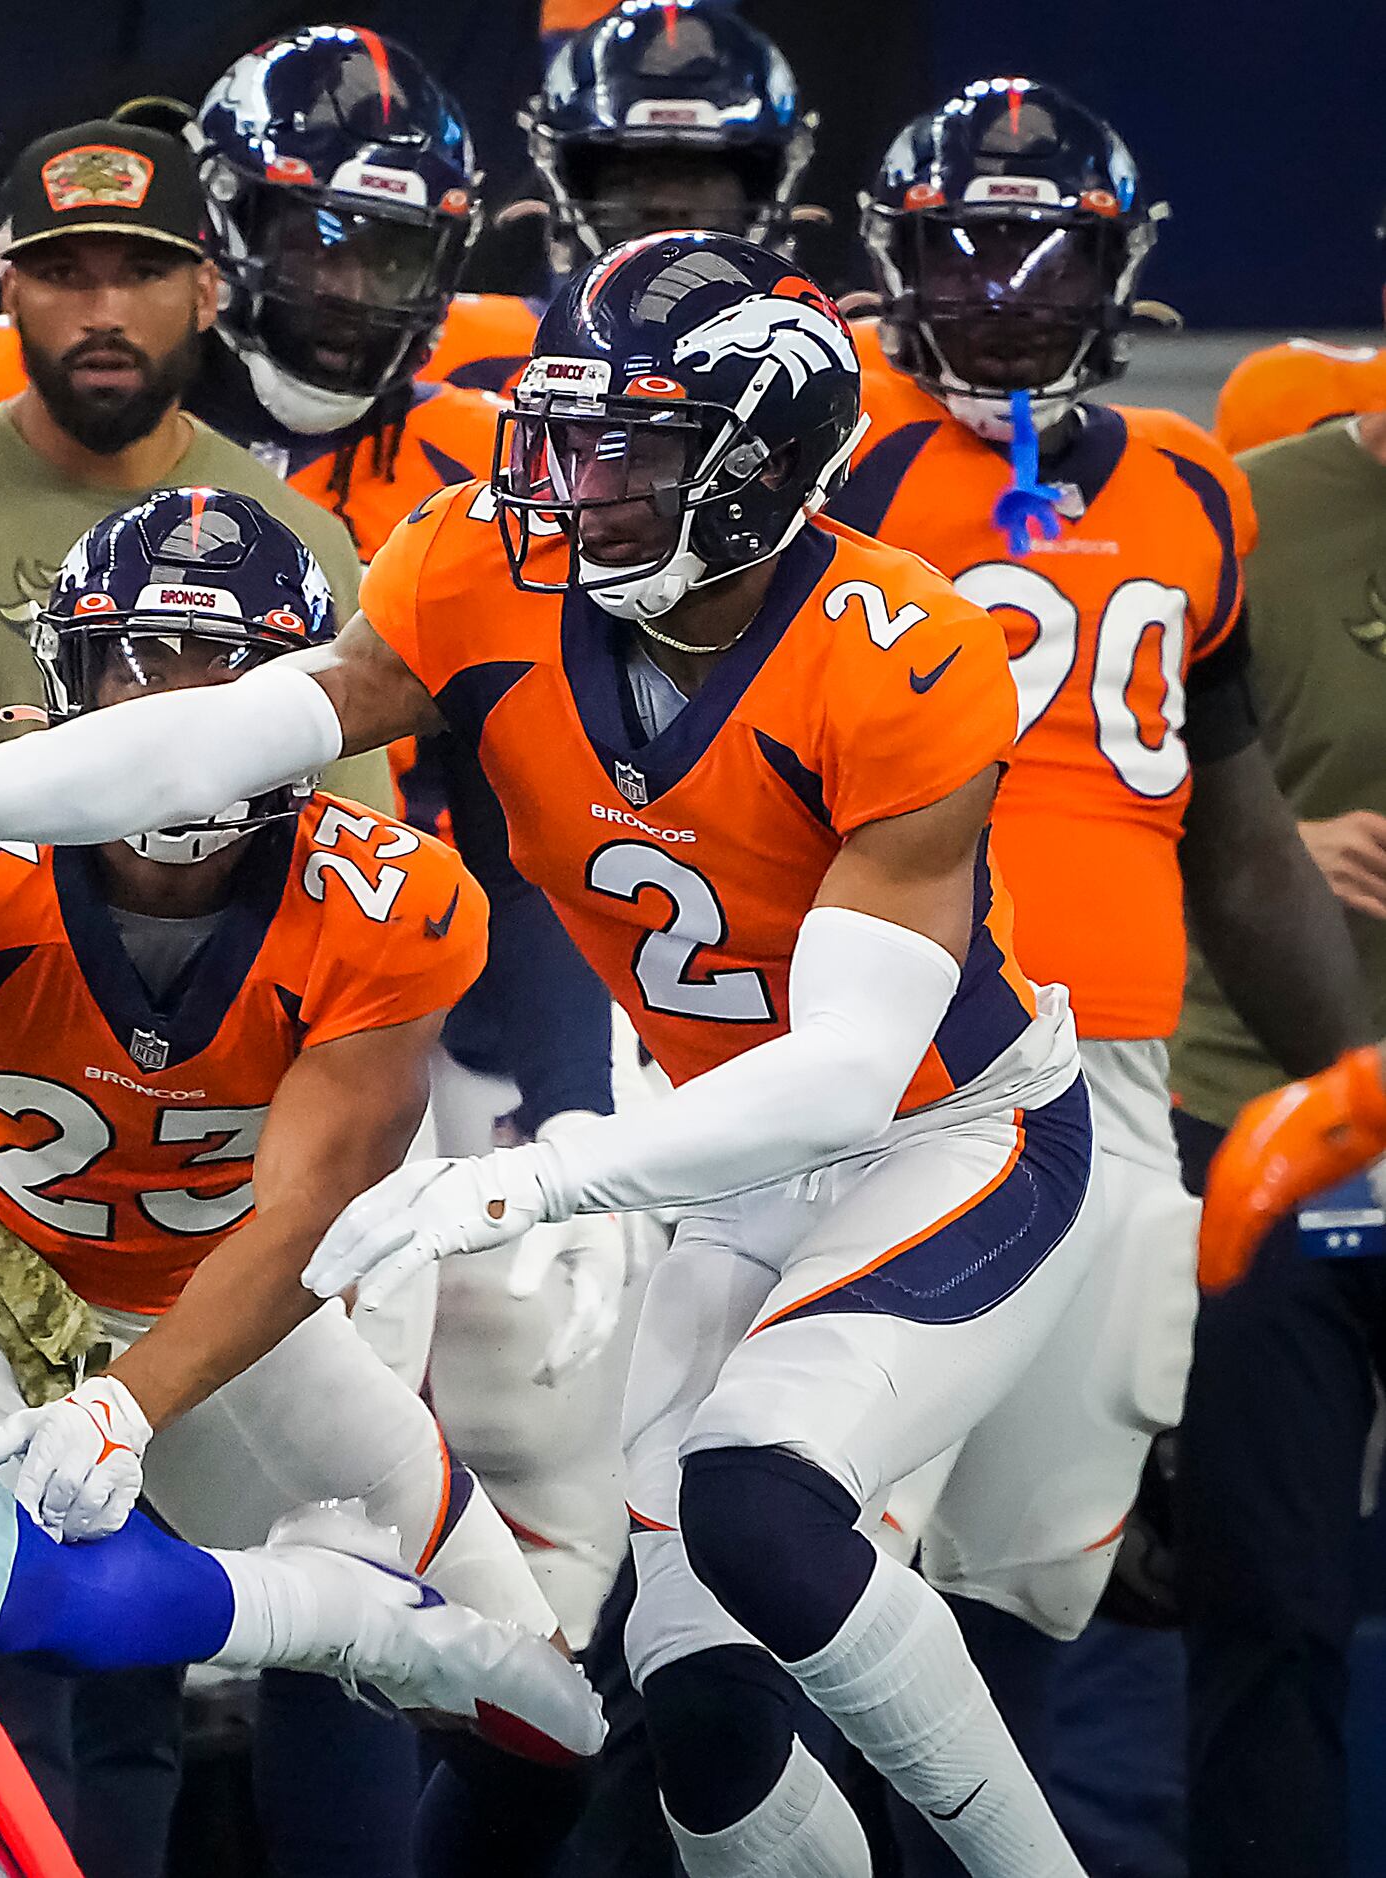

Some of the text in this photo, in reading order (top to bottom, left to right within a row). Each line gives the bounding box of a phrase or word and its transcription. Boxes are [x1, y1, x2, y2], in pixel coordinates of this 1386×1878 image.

[160, 590, 216, 608] BRONCOS
[823, 580, 930, 651] 2
[591, 803, 696, 842] BRONCOS
[303, 805, 420, 922] 23
[584, 838, 778, 1024] 2
[84, 1066, 206, 1100] BRONCOS
